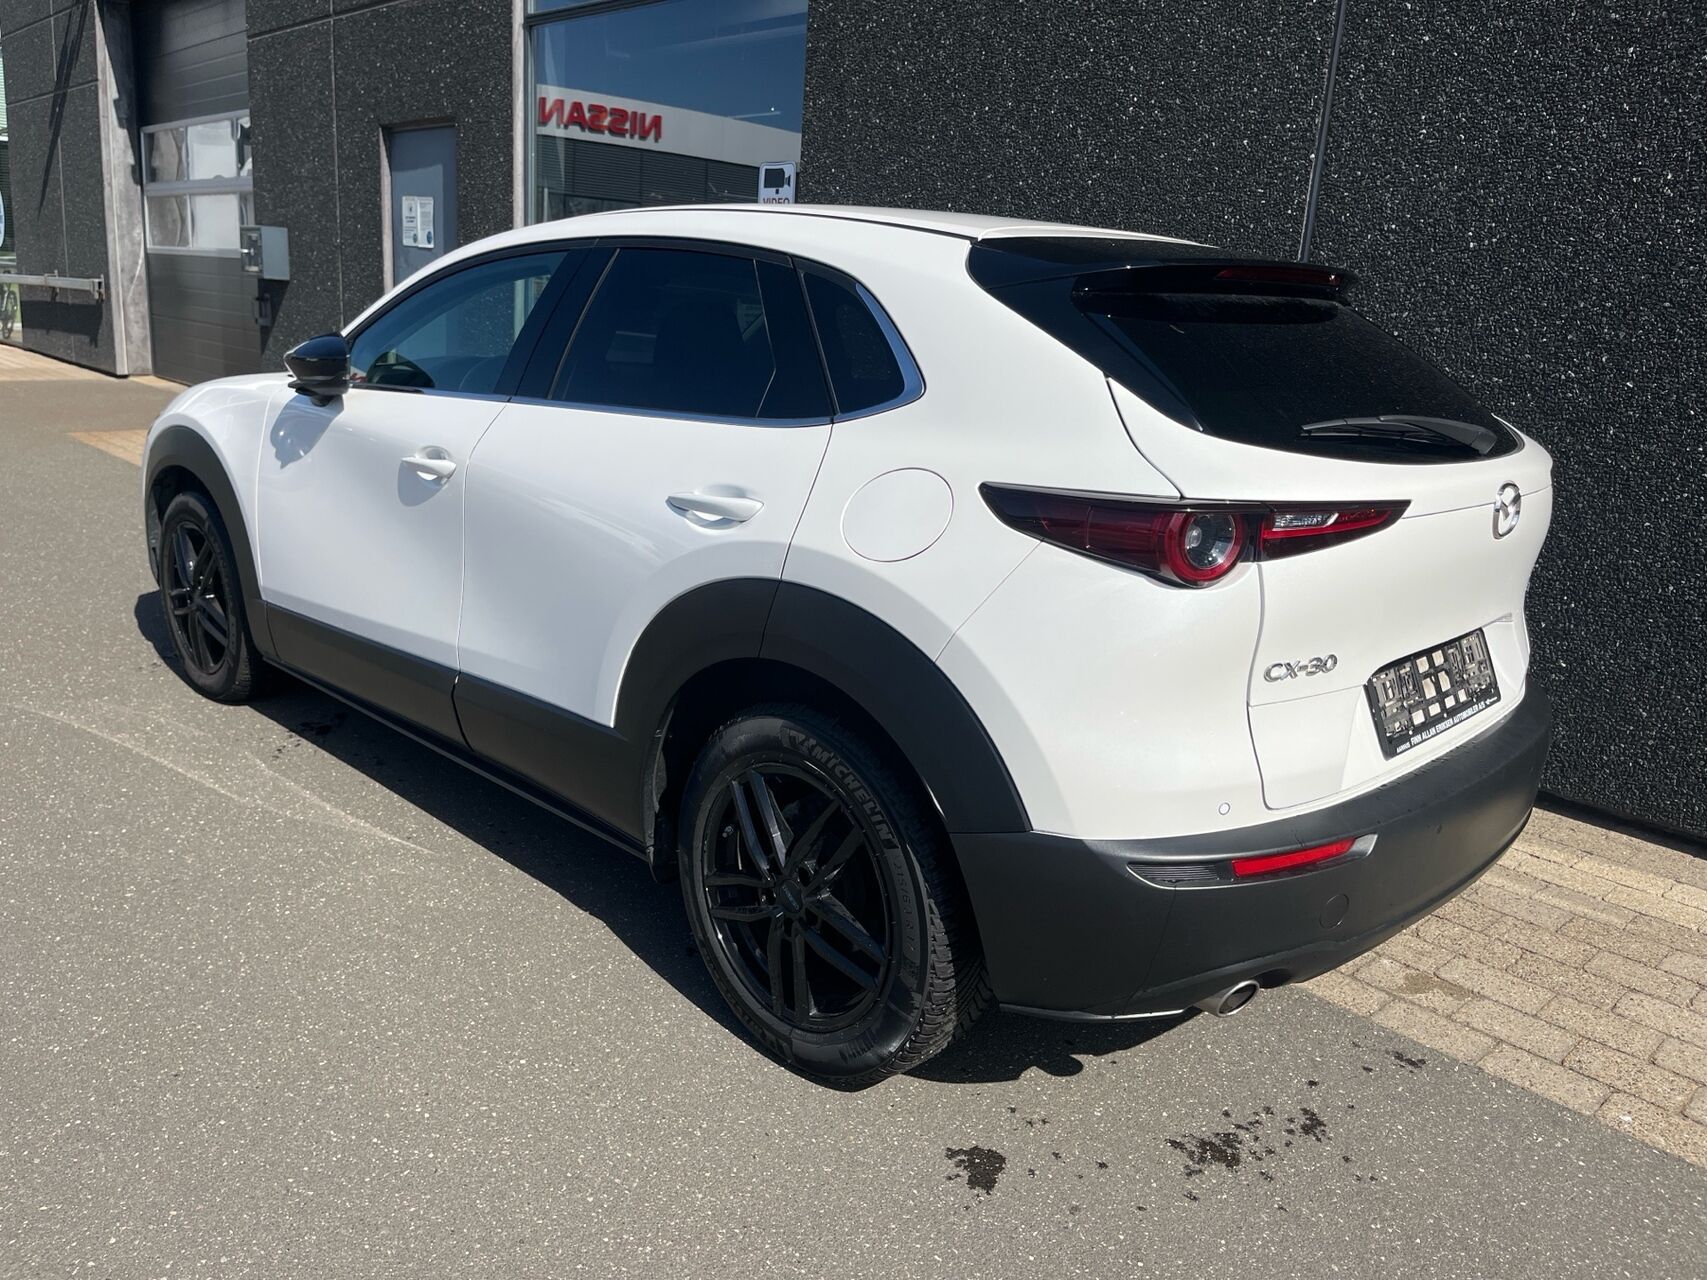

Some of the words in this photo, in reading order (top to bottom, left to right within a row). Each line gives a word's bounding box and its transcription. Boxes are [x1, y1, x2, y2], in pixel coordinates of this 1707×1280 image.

[1263, 653, 1338, 682] CX-30
[1411, 734, 1422, 746] FINN
[1421, 726, 1437, 741] ALLAN
[1435, 718, 1454, 733] ERIKSEN
[1453, 704, 1479, 724] AUTOMOBILER
[812, 745, 894, 840] MICHELIN
